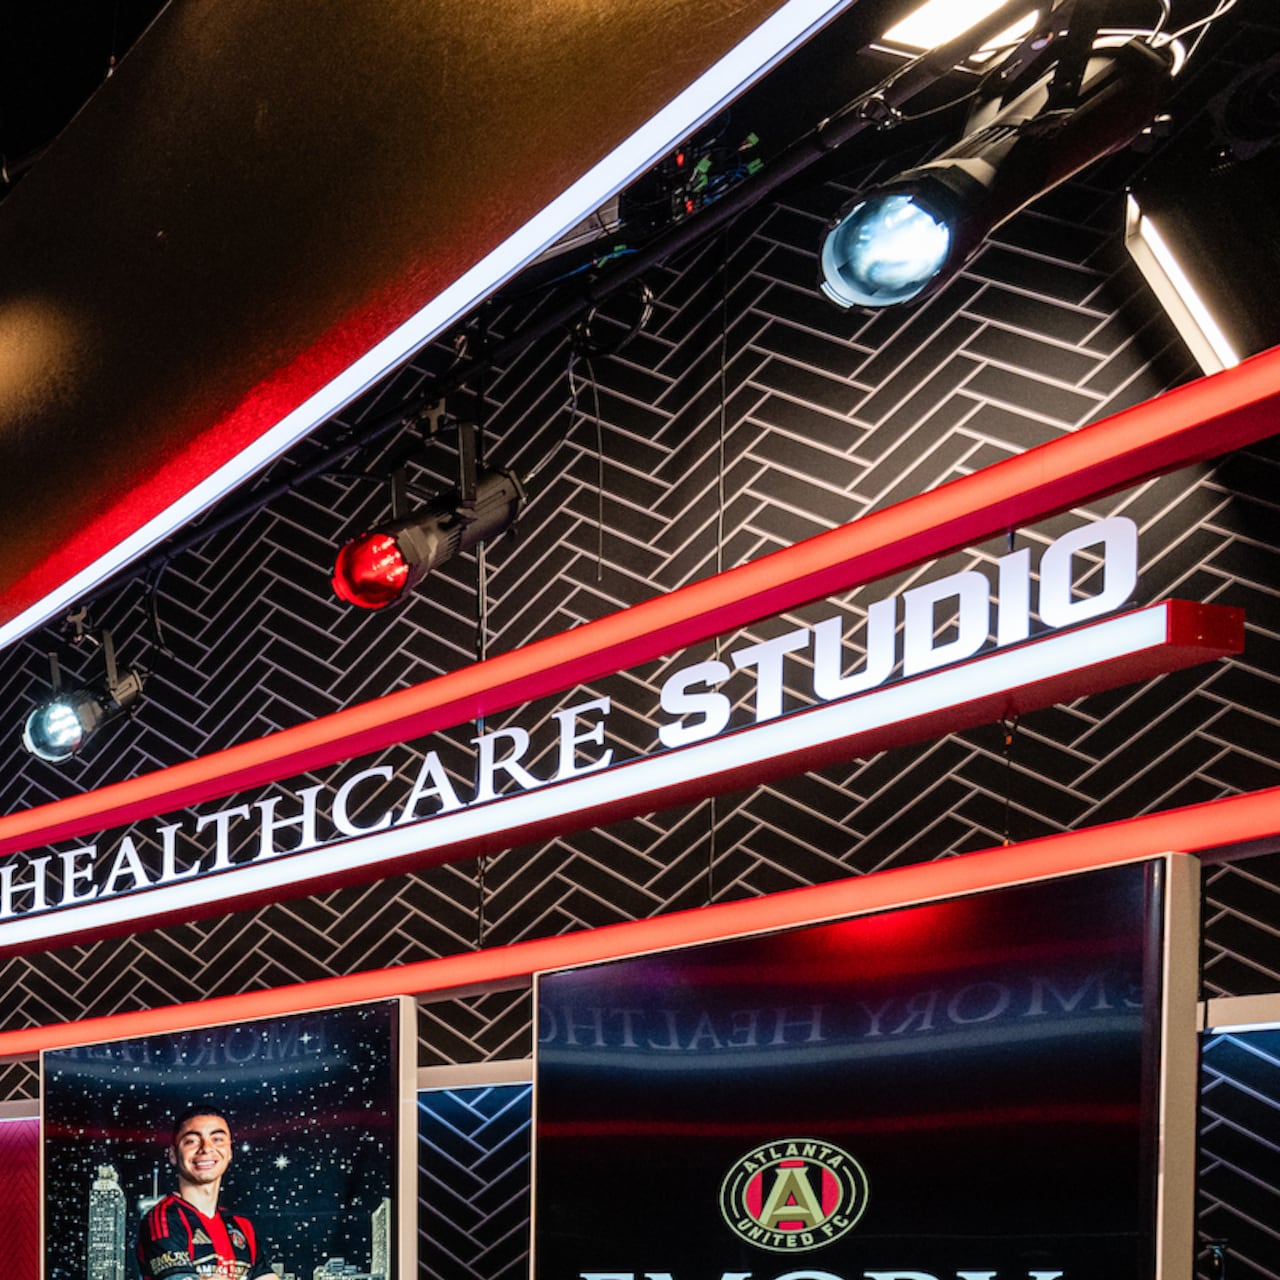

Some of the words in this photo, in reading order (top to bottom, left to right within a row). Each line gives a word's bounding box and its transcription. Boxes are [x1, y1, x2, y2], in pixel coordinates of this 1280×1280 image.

[658, 516, 1139, 749] STUDIO
[742, 1143, 844, 1173] ATLANTA
[737, 1218, 814, 1248] UNITED
[820, 1215, 849, 1237] FC
